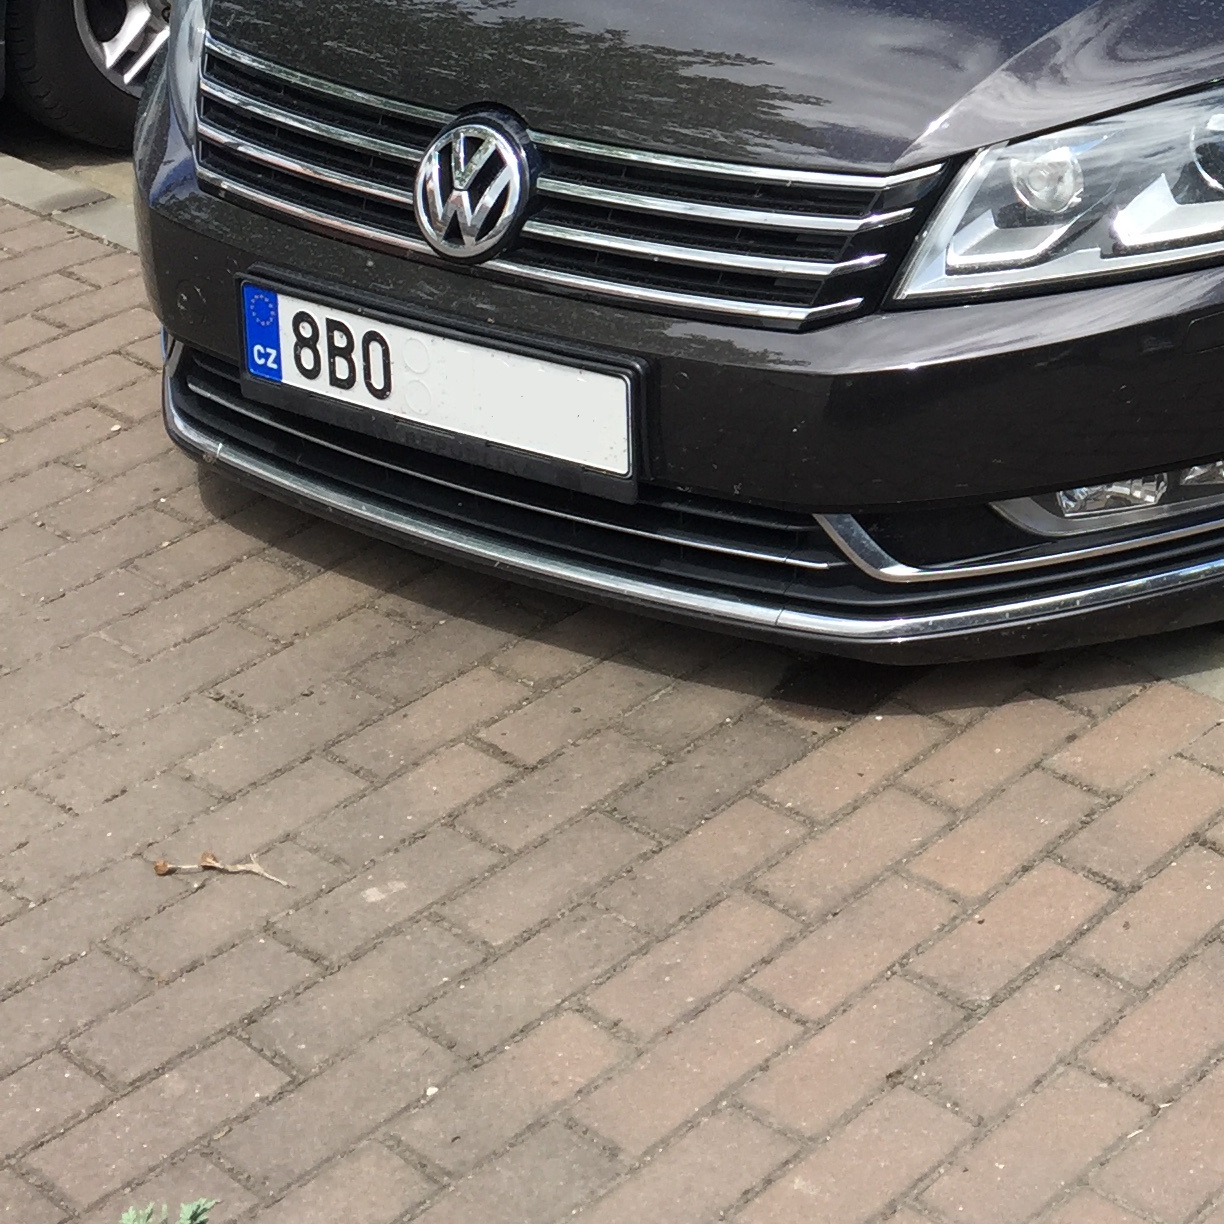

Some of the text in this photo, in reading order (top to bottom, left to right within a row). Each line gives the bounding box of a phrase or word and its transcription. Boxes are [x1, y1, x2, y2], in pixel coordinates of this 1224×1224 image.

[414, 123, 522, 257] VW
[253, 344, 279, 370] CZ
[291, 310, 393, 401] 8B0
